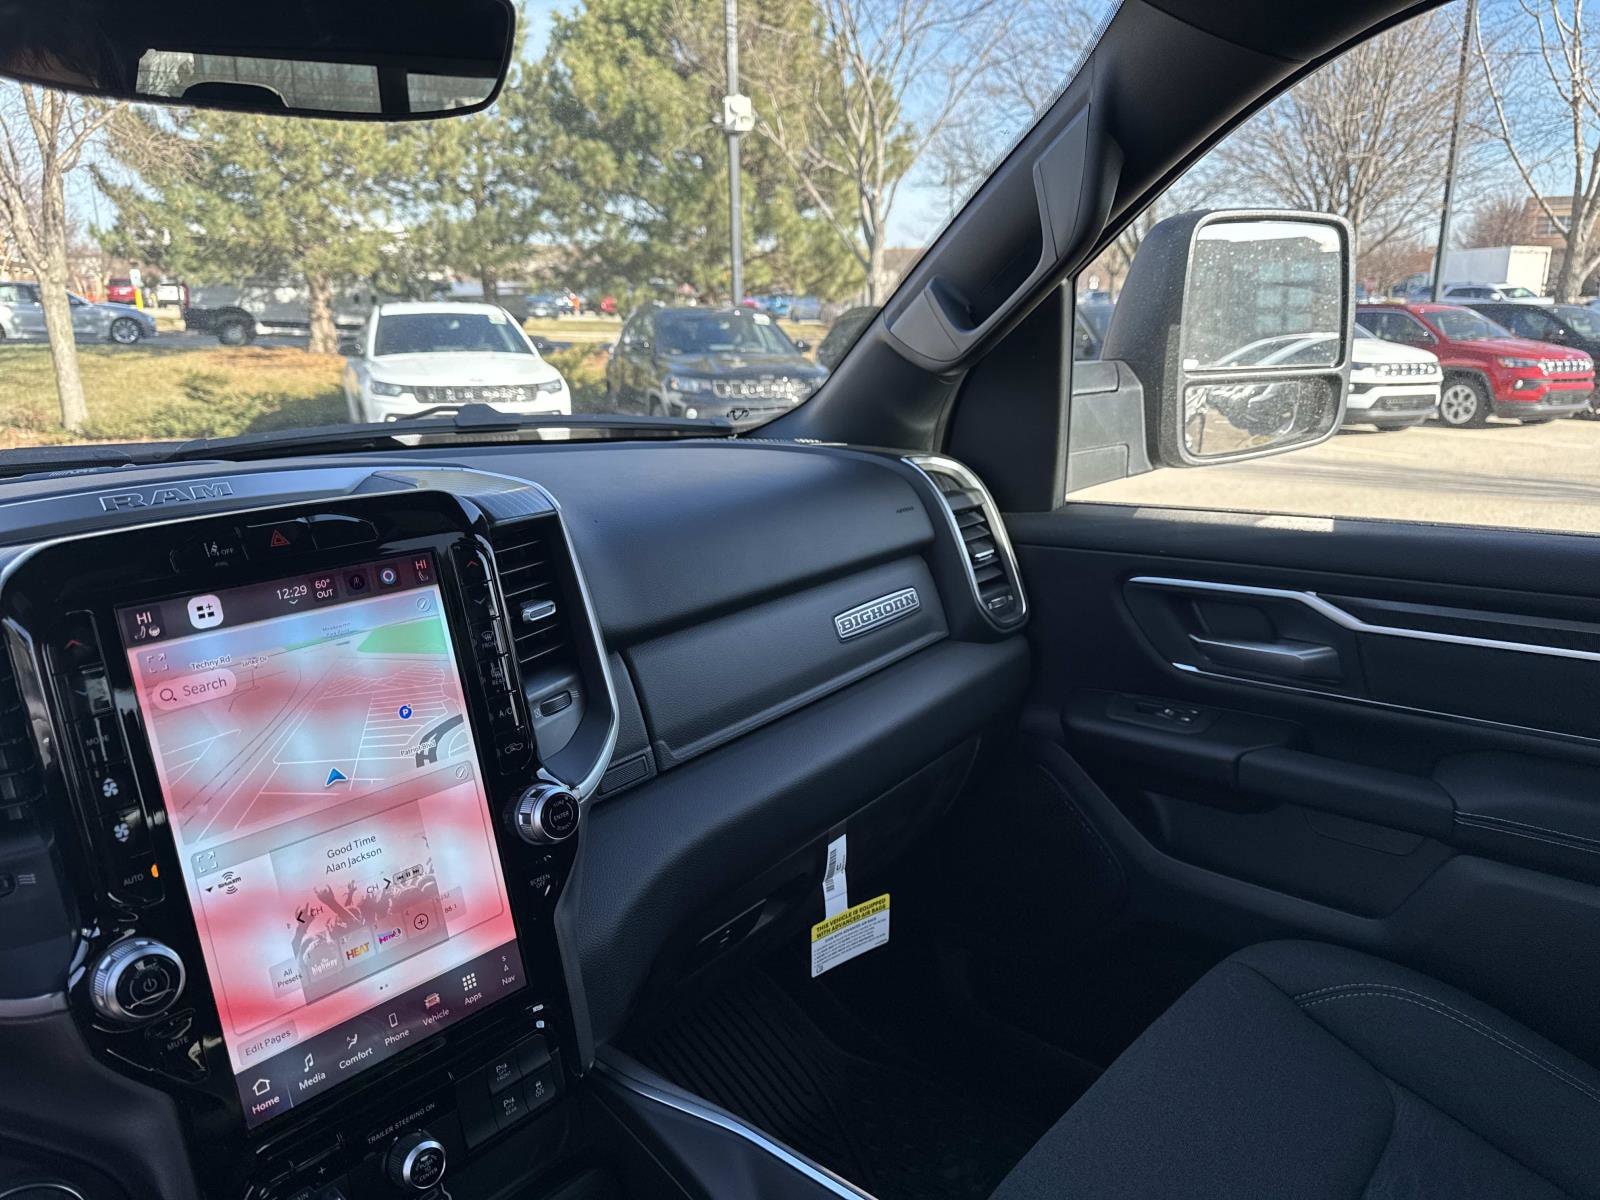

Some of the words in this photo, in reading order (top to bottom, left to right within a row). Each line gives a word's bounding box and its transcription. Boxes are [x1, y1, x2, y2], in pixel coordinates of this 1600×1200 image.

[99, 481, 234, 512] RAM
[415, 559, 427, 570] HI
[276, 585, 308, 600] 12:29
[316, 589, 333, 599] OUT
[136, 611, 153, 625] HI
[839, 593, 917, 633] BIGHORN
[192, 658, 219, 671] Techny
[220, 655, 231, 664] Rd
[182, 677, 227, 697] Search
[327, 842, 353, 859] Good
[353, 835, 376, 849] Time
[326, 860, 347, 874] Alan
[347, 847, 382, 868] Jackson
[123, 873, 144, 886] AUTO
[367, 884, 379, 894] CH
[816, 922, 829, 932] THIS
[830, 913, 851, 928] VEHICLE
[859, 898, 886, 914] EQUIPPED
[816, 929, 831, 939] WITH
[831, 916, 861, 933] ADVANCED
[346, 942, 370, 960] HEAT
[283, 968, 293, 977] All
[501, 975, 516, 986] Nav
[464, 992, 482, 1006] Apps
[422, 1008, 450, 1026] Vehicle
[167, 1036, 189, 1050] MUTE
[245, 1042, 263, 1056] Edit
[264, 1030, 291, 1047] Pages
[384, 1029, 410, 1046] Phone
[338, 1047, 373, 1069] Comfort
[299, 1072, 326, 1090] Media
[251, 1095, 280, 1115] Home
[367, 1126, 395, 1144] TRAILER
[395, 1110, 425, 1129] STEERING
[426, 1103, 435, 1113] ON
